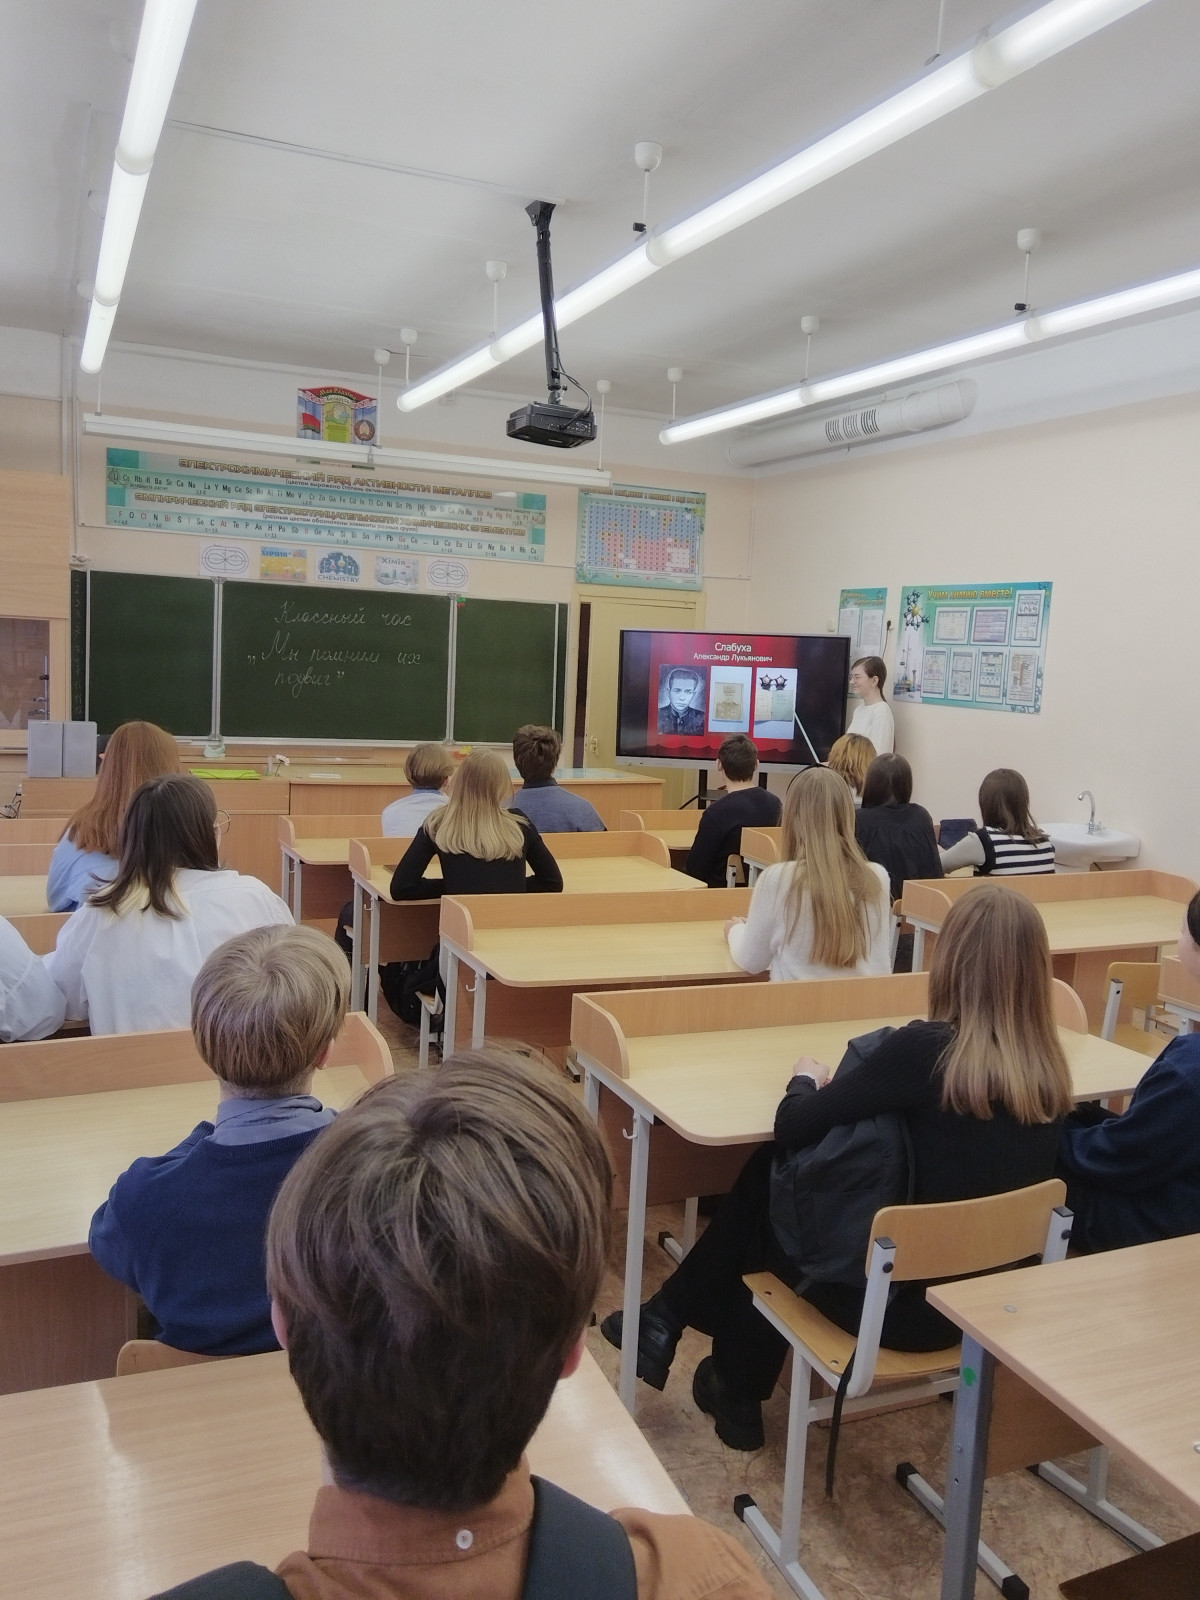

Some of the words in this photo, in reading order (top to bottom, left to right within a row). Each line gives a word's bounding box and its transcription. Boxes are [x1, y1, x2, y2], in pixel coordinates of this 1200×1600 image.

[179, 459, 325, 482] ЭЛЕКТРОХИМИЧЕСКИЙ
[327, 474, 352, 487] РЯД
[353, 477, 431, 493] АКТИВНОСТИ
[433, 485, 492, 500] МЕТАЛЛОВ
[135, 492, 229, 509] ЭМПИРИЧЕСКИЙ
[230, 501, 253, 512] РЯД
[470, 524, 526, 536] ЭЛЕМЕНТОВ
[318, 574, 360, 584] CHEMISTRY
[928, 590, 948, 599] Учим
[950, 590, 978, 599] химию
[980, 587, 1013, 598] вместе!
[274, 600, 366, 624] Классный
[381, 612, 412, 626] час
[714, 642, 752, 653] Слабуха
[310, 650, 380, 664] помним
[397, 652, 421, 664] их
[693, 652, 730, 662] Александр
[731, 654, 773, 662] Лукьянович
